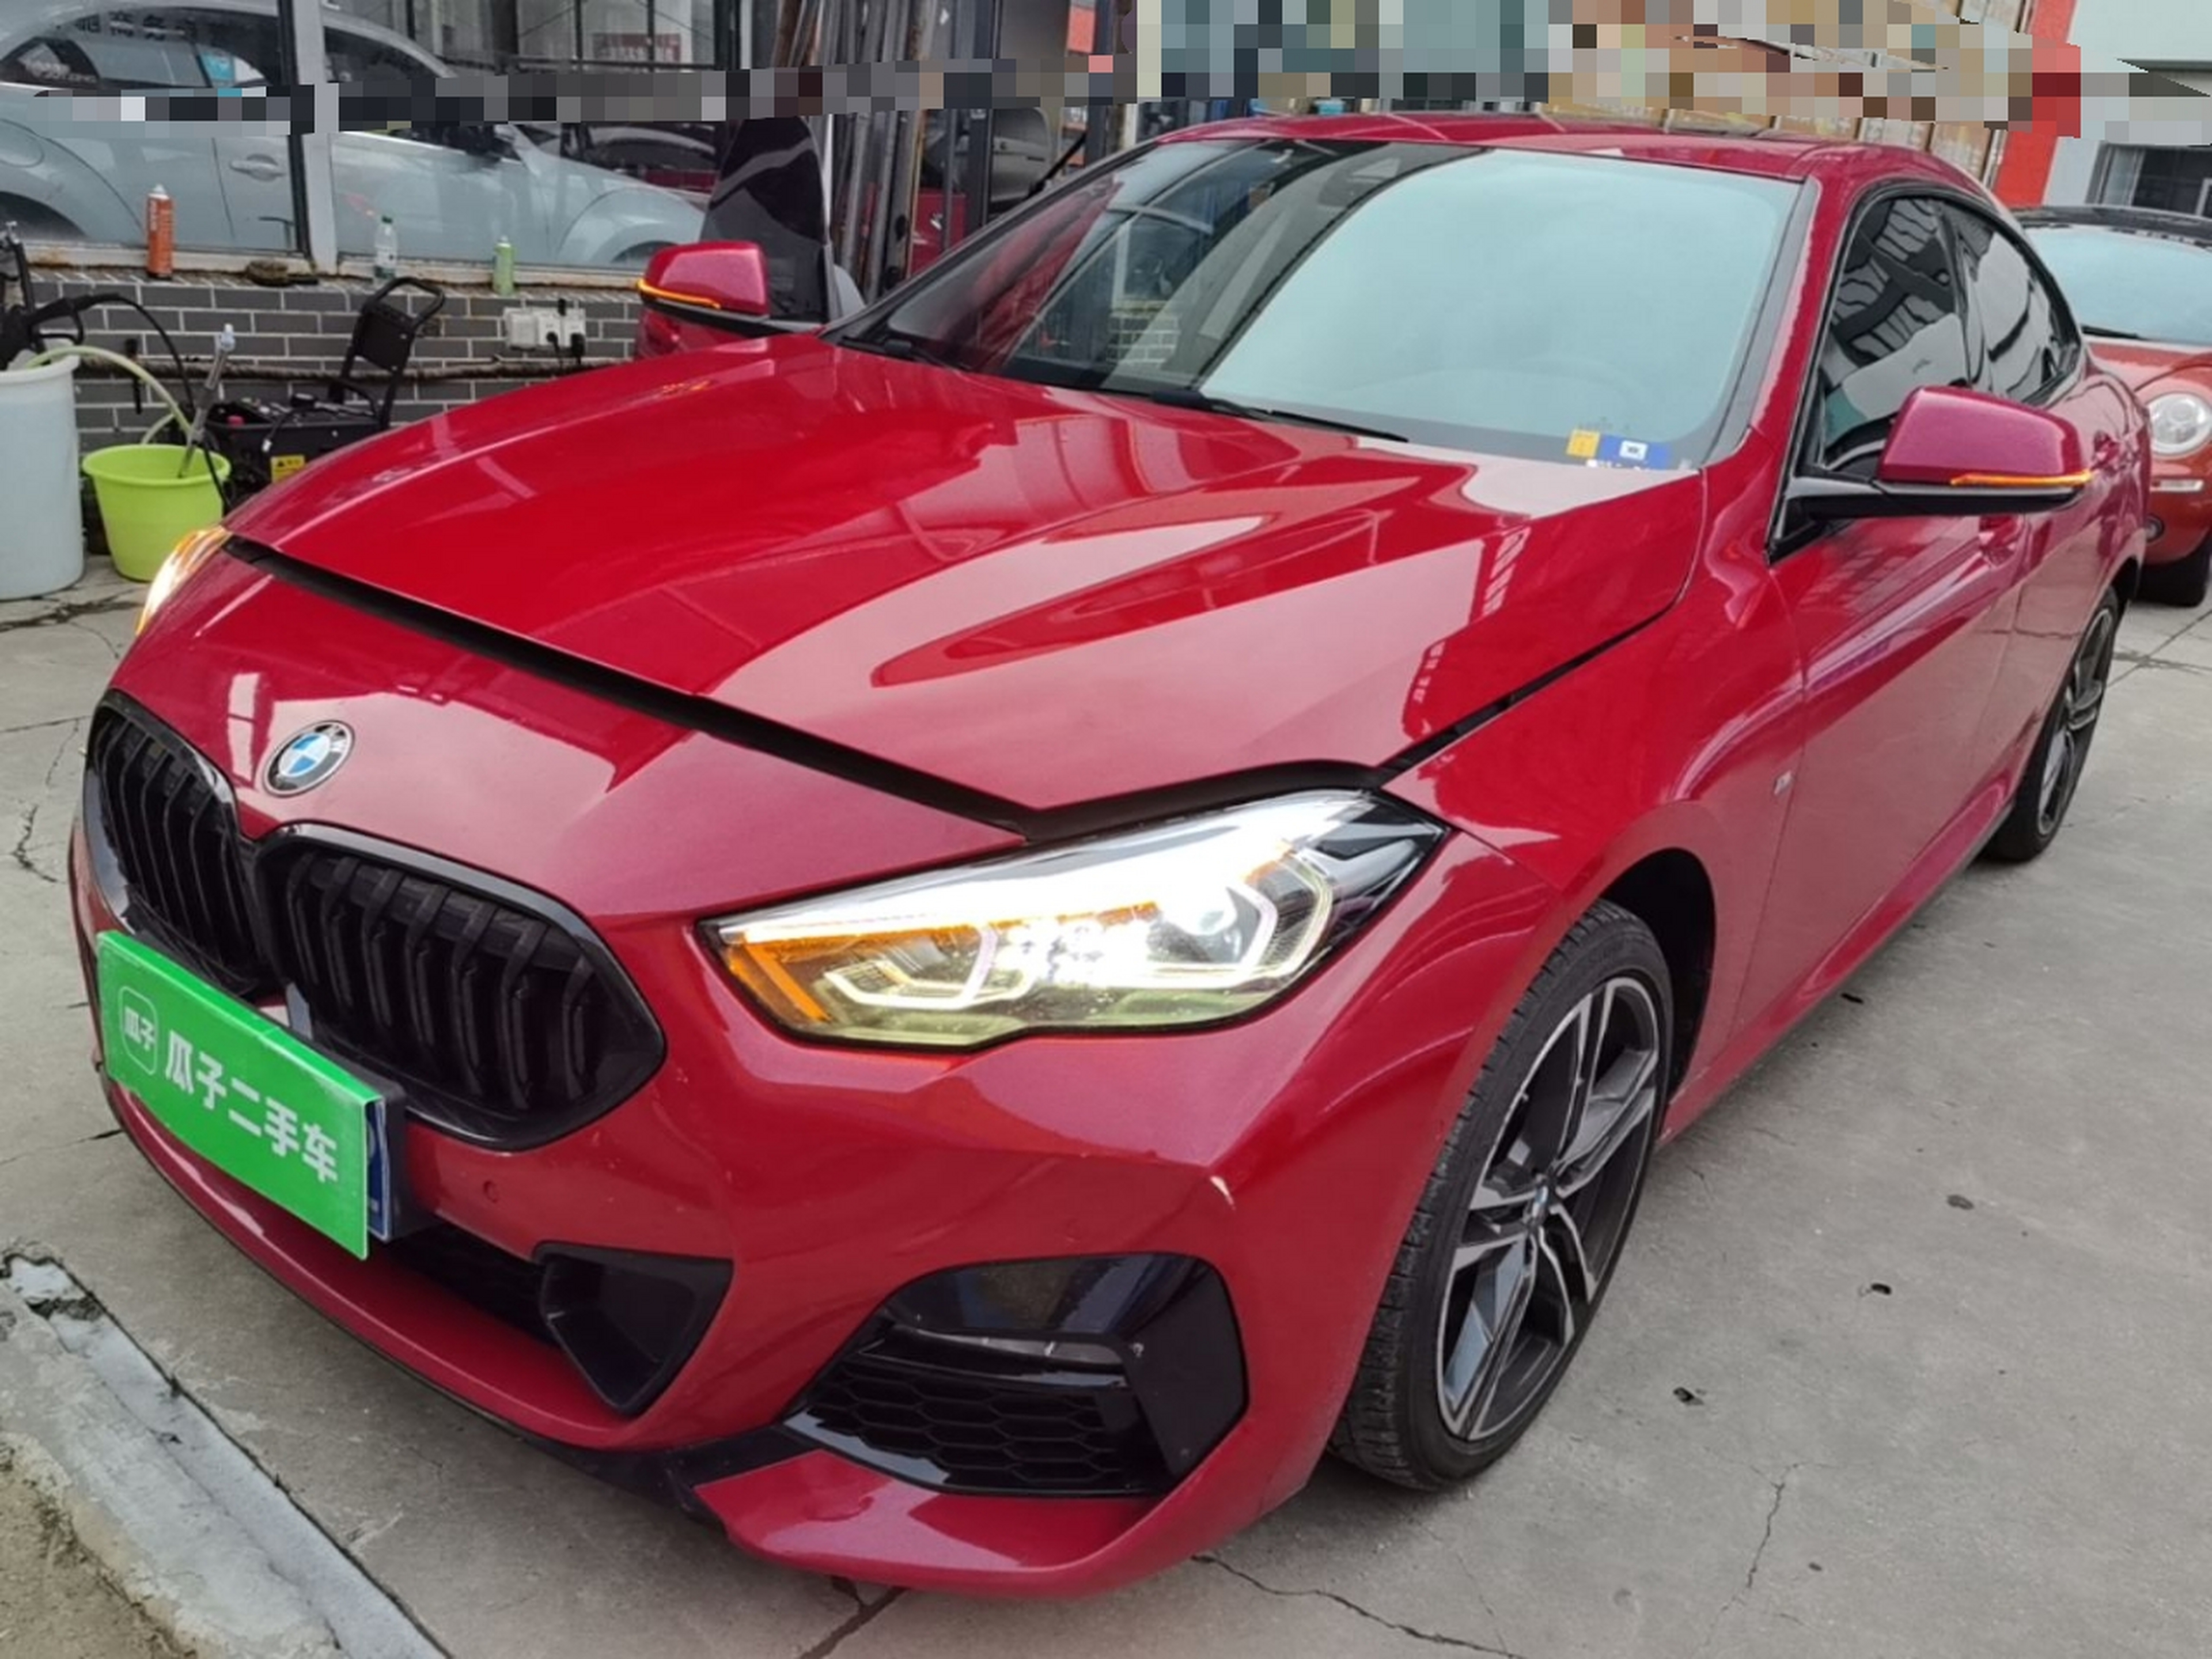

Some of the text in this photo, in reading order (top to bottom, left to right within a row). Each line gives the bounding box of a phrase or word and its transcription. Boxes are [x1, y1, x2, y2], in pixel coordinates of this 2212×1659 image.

[165, 1030, 338, 1183] 瓜子二手车
